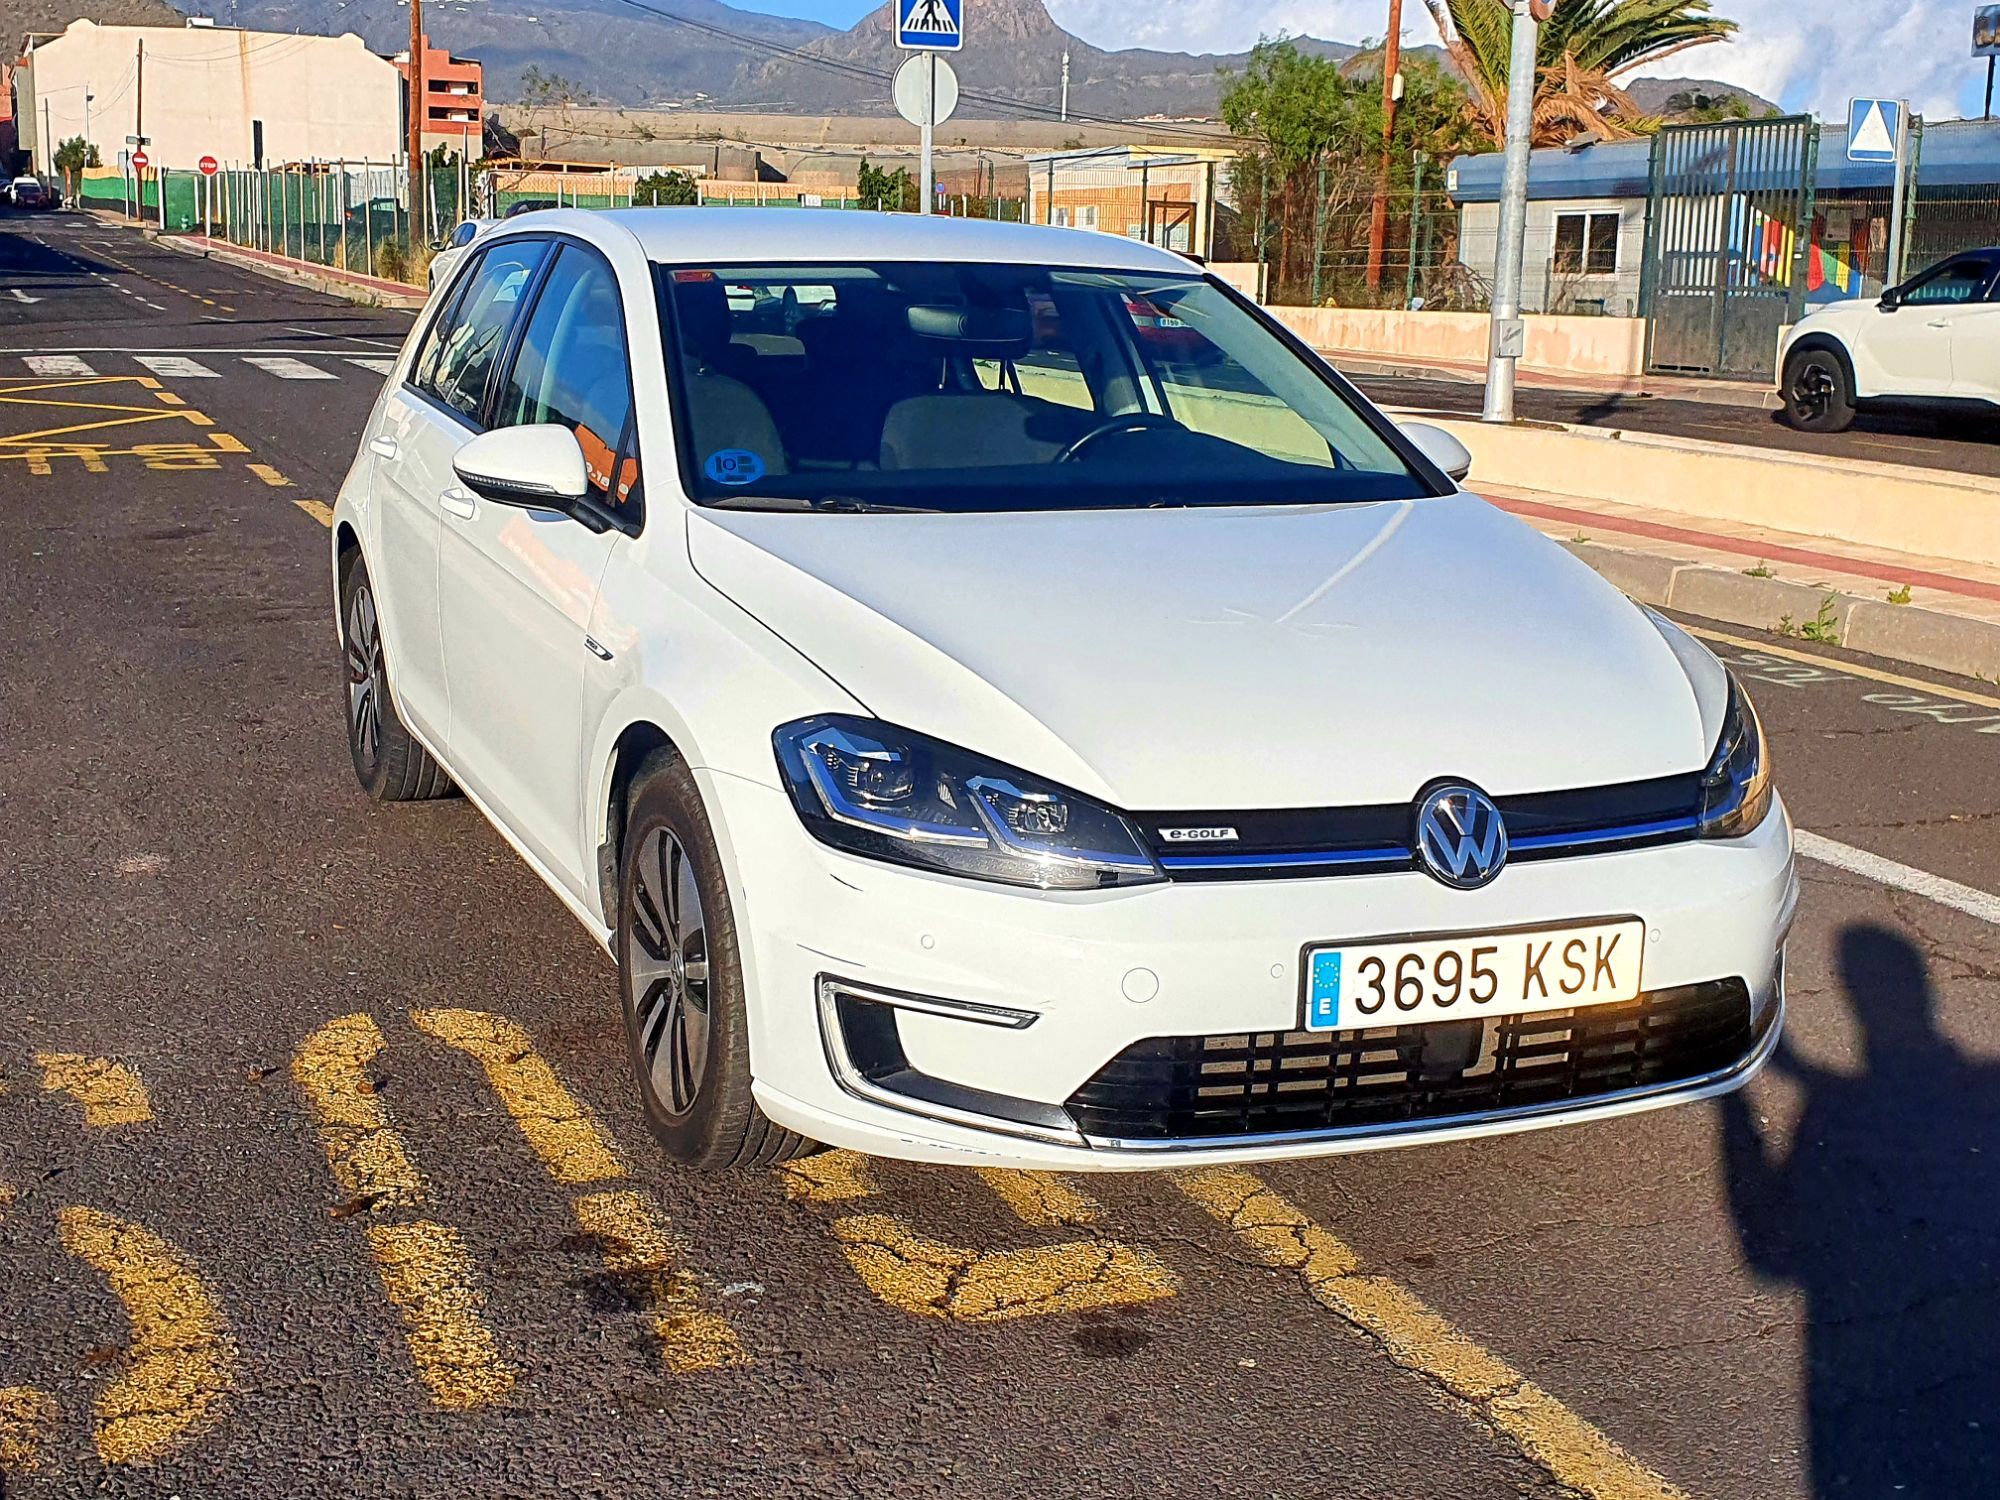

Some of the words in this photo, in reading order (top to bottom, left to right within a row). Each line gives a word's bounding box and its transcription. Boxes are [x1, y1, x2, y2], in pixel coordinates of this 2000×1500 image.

[1355, 946, 1499, 1015] 3695
[1522, 933, 1621, 1000] KSK
[1318, 998, 1331, 1014] E
